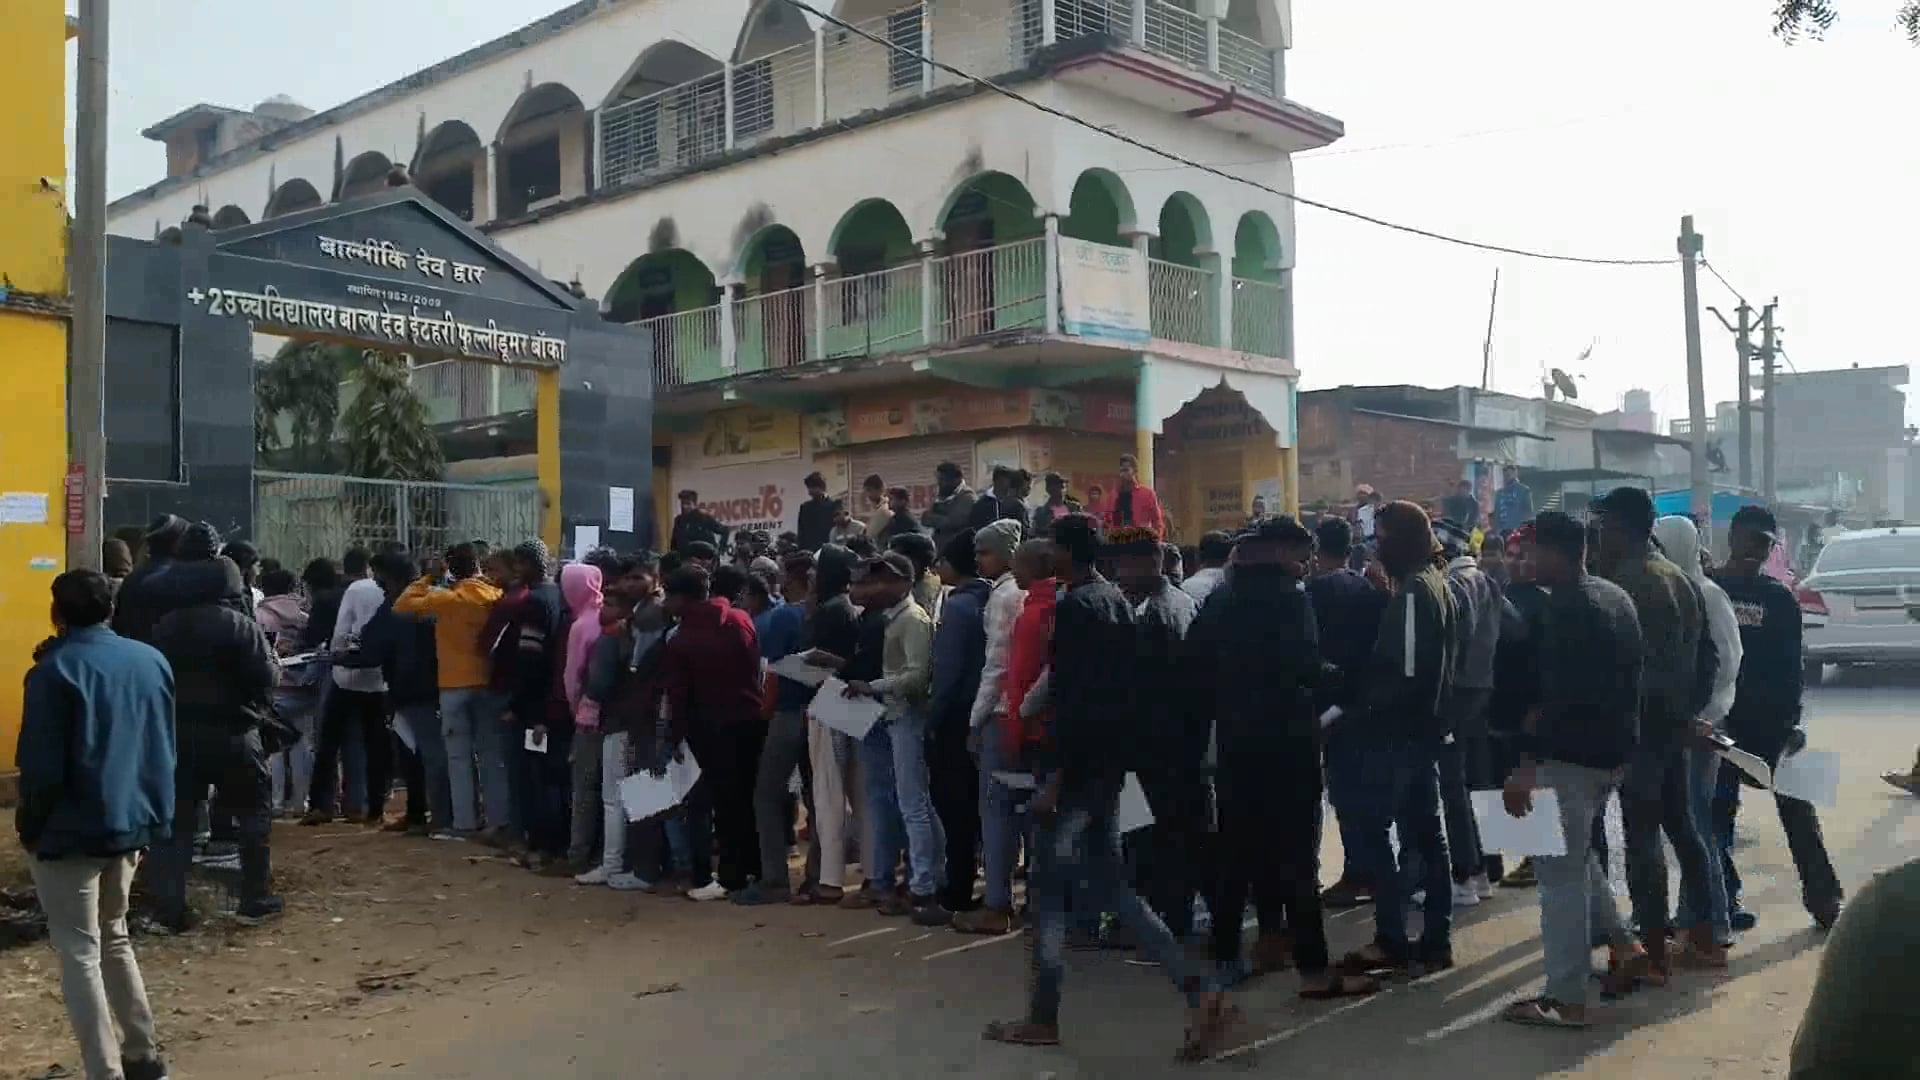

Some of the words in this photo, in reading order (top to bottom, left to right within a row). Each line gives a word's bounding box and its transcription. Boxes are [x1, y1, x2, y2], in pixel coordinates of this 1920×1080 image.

[415, 248, 446, 277] देव
[451, 261, 487, 284] द्वार
[380, 301, 407, 339] देव
